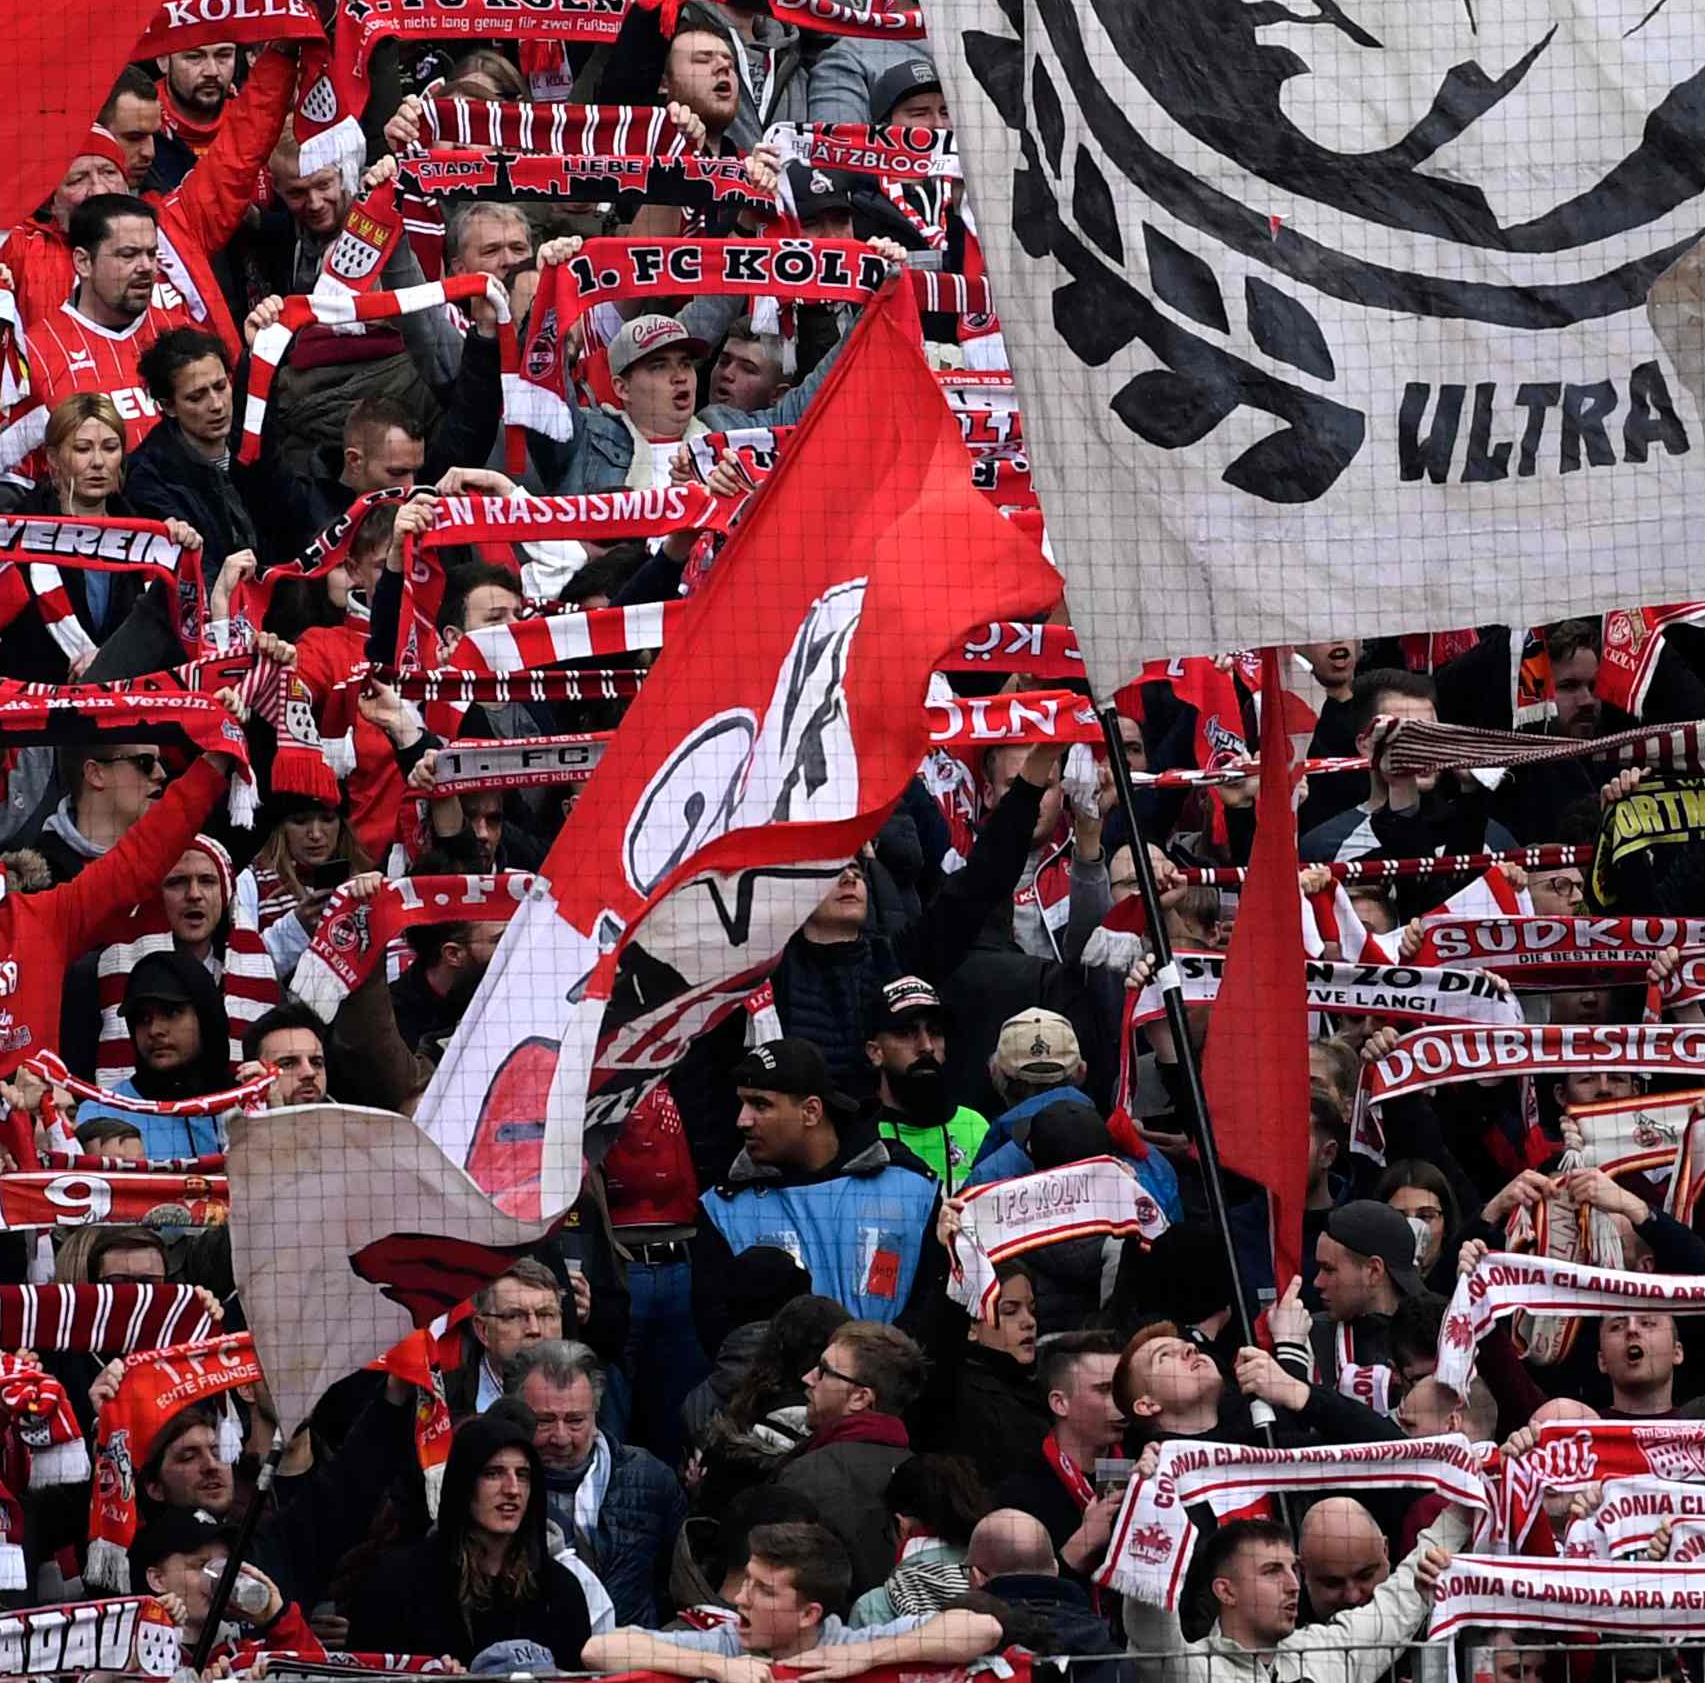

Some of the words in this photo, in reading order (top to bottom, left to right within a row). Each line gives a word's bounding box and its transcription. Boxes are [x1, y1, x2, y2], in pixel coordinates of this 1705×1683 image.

[563, 159, 642, 176] LIEBE
[570, 258, 616, 294] 1.
[634, 248, 700, 282] FC
[1399, 360, 1690, 484] ULTRA
[484, 487, 686, 525] RASSISMUS
[43, 696, 115, 713] Mein
[524, 748, 589, 764] FC
[1552, 1271, 1664, 1299] CLAUDIA
[1513, 1581, 1613, 1606] CLAUDIA
[1620, 1588, 1667, 1608] ARA
